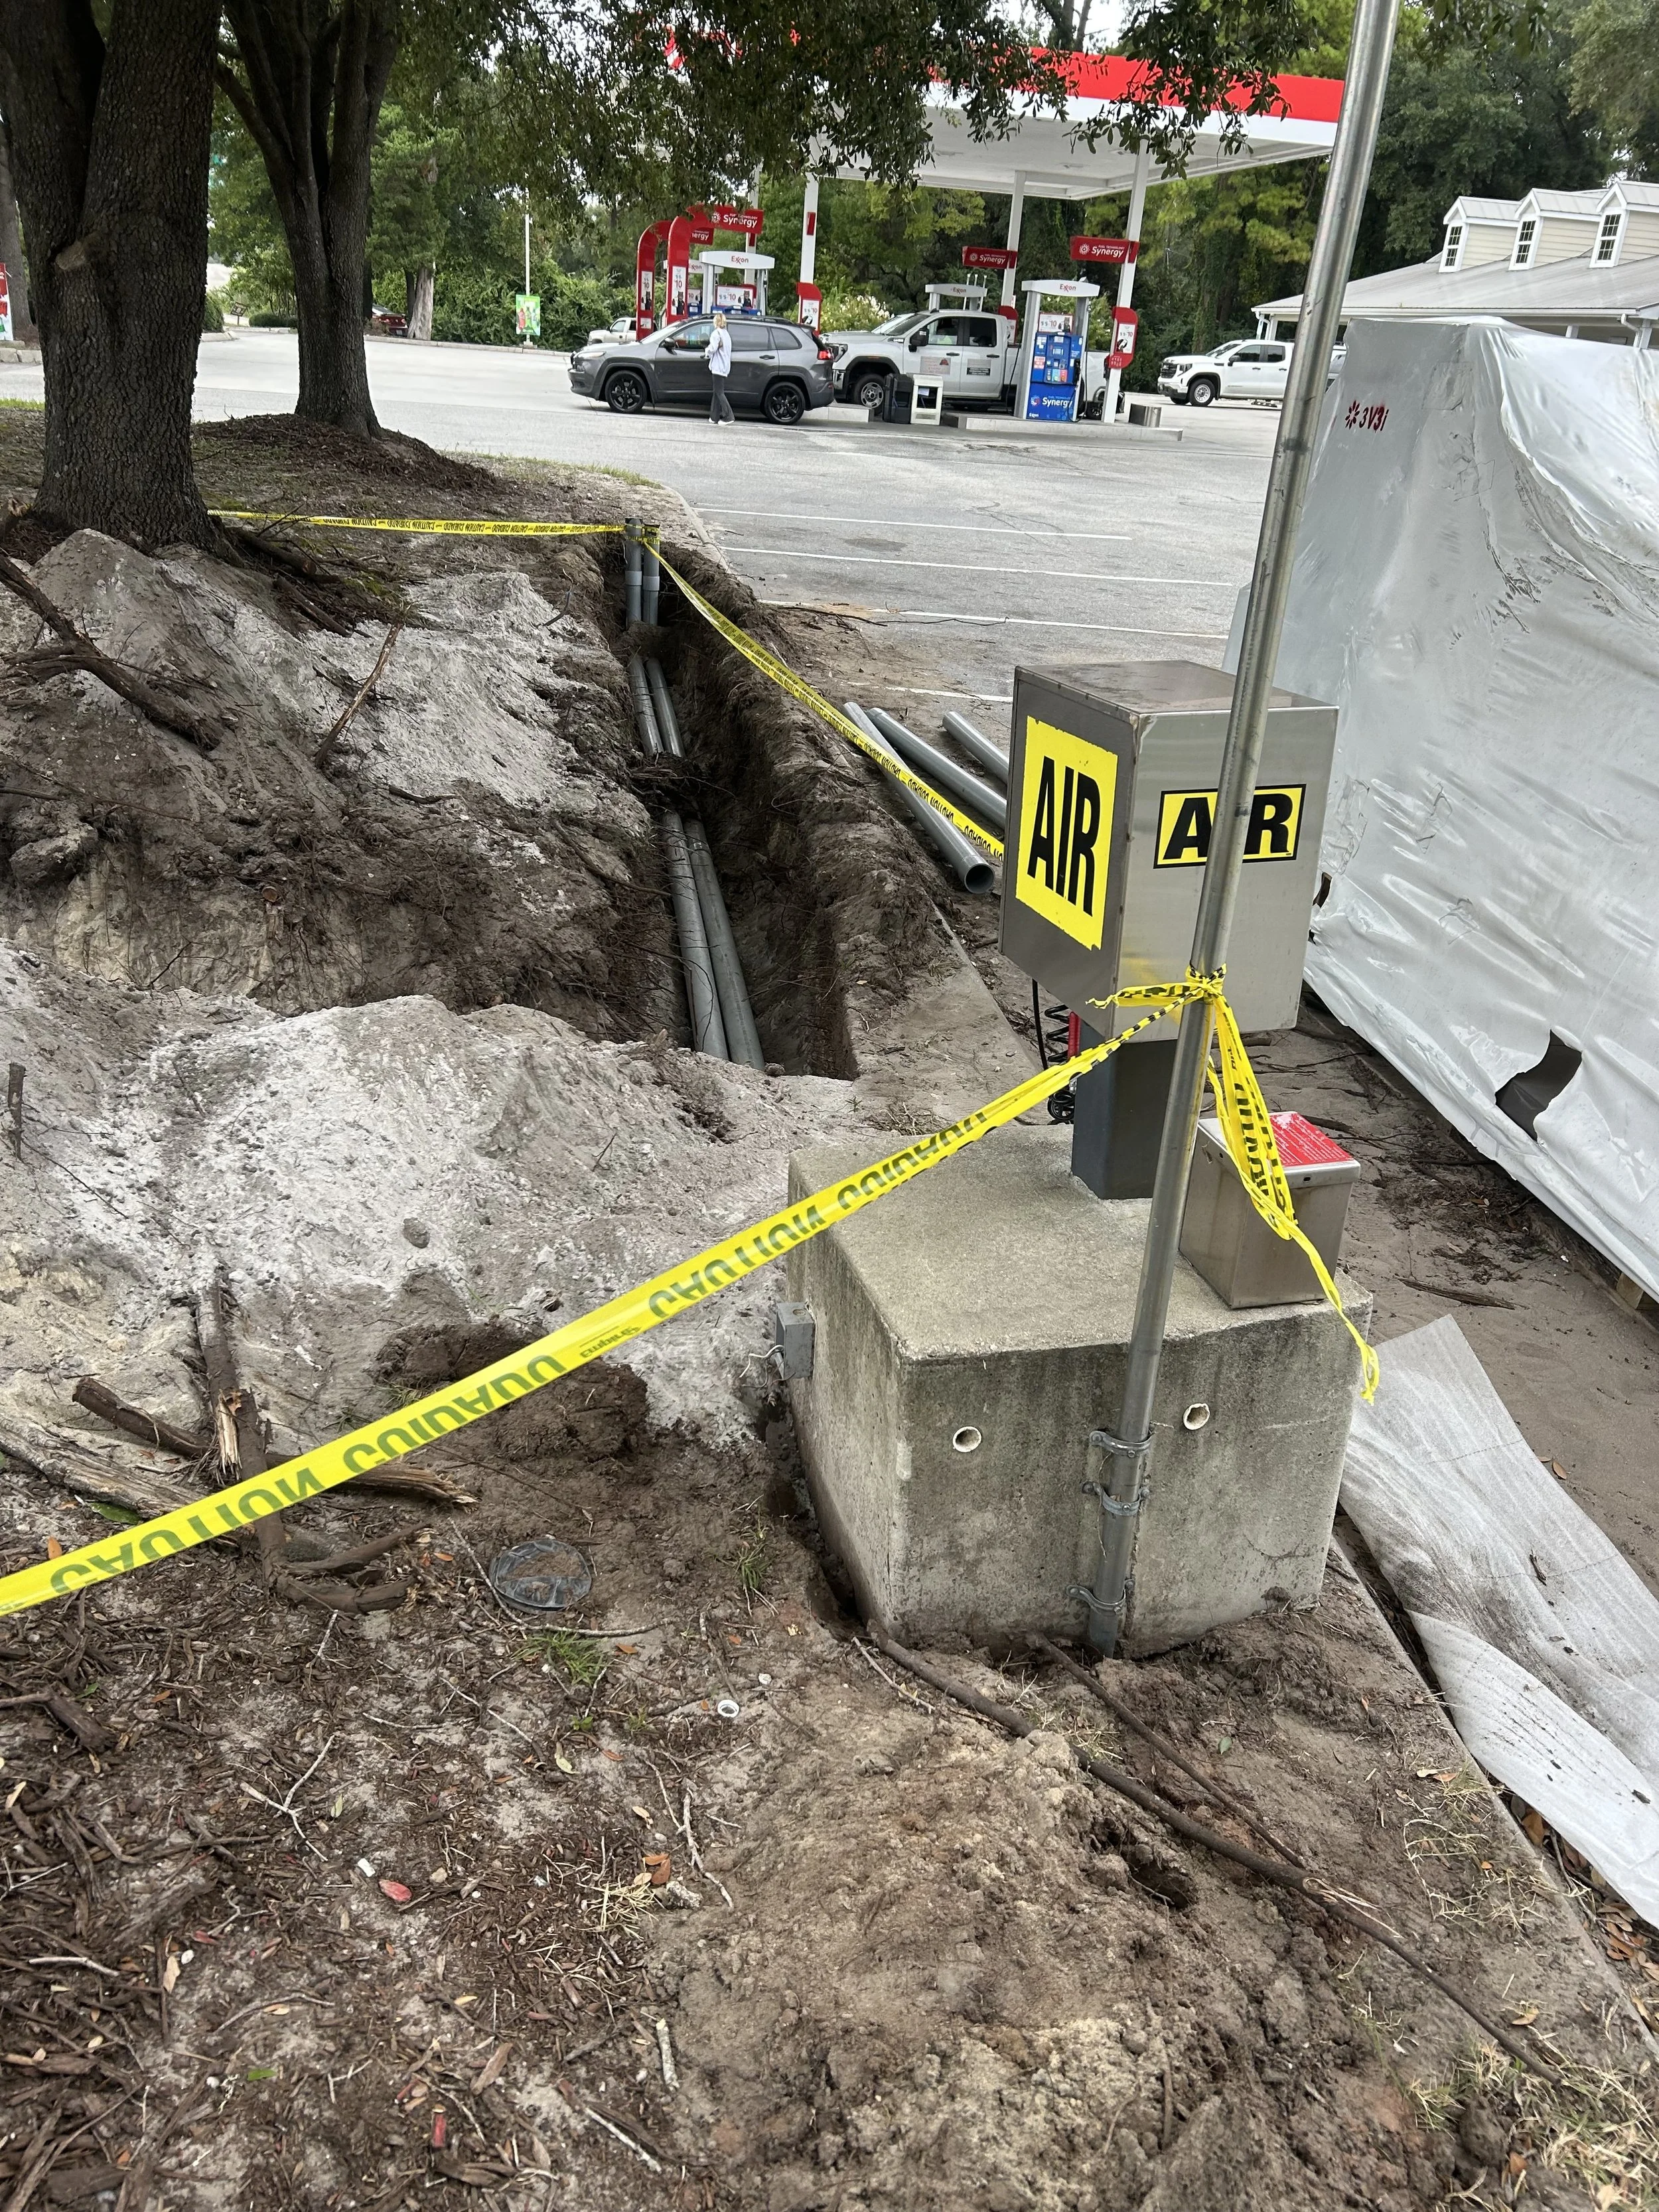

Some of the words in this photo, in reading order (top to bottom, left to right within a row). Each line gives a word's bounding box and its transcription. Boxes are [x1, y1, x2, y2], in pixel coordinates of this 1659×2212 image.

[1092, 246, 1124, 258] Synergy
[731, 256, 749, 265] Exxon
[979, 254, 1005, 265] Synergy
[1043, 397, 1073, 408] Synergy
[412, 521, 435, 530] CAUTION
[443, 522, 465, 532] CUIDADO
[465, 523, 485, 532] CAUTION
[1163, 793, 1290, 860] AR
[1027, 755, 1102, 917] AIR
